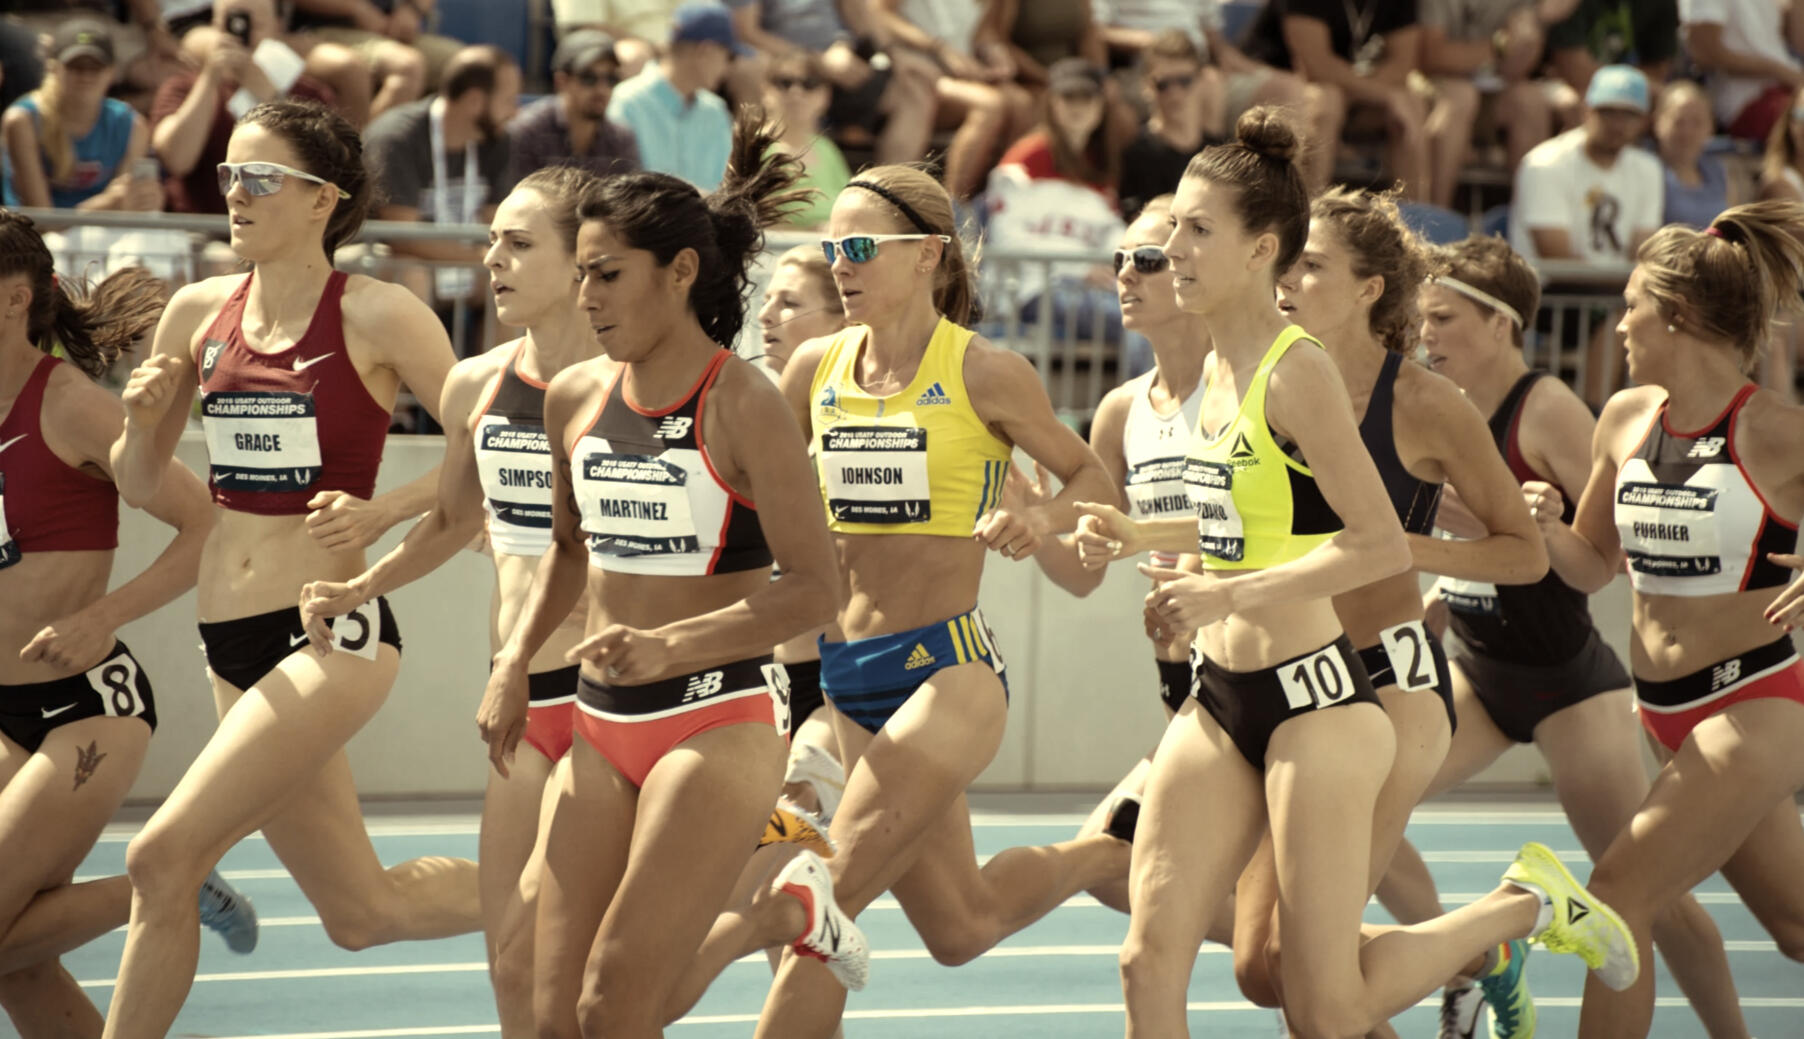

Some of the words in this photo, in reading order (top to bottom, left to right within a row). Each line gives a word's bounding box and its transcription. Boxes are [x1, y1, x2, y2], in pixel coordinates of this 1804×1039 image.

[207, 403, 306, 415] CHAMPIONSHIPS
[916, 396, 951, 406] adidas
[234, 433, 282, 452] GRACE
[829, 438, 919, 449] CHAMPIONSHIPS
[498, 468, 552, 489] SIMPSO
[600, 498, 668, 521] MARTINEZ
[1622, 491, 1707, 509] CHAMPIONSHIPS
[1633, 521, 1689, 541] PURRIER
[904, 656, 937, 671] adidas
[1393, 626, 1431, 688] 2
[1292, 654, 1343, 705] 10
[102, 664, 135, 717] 8
